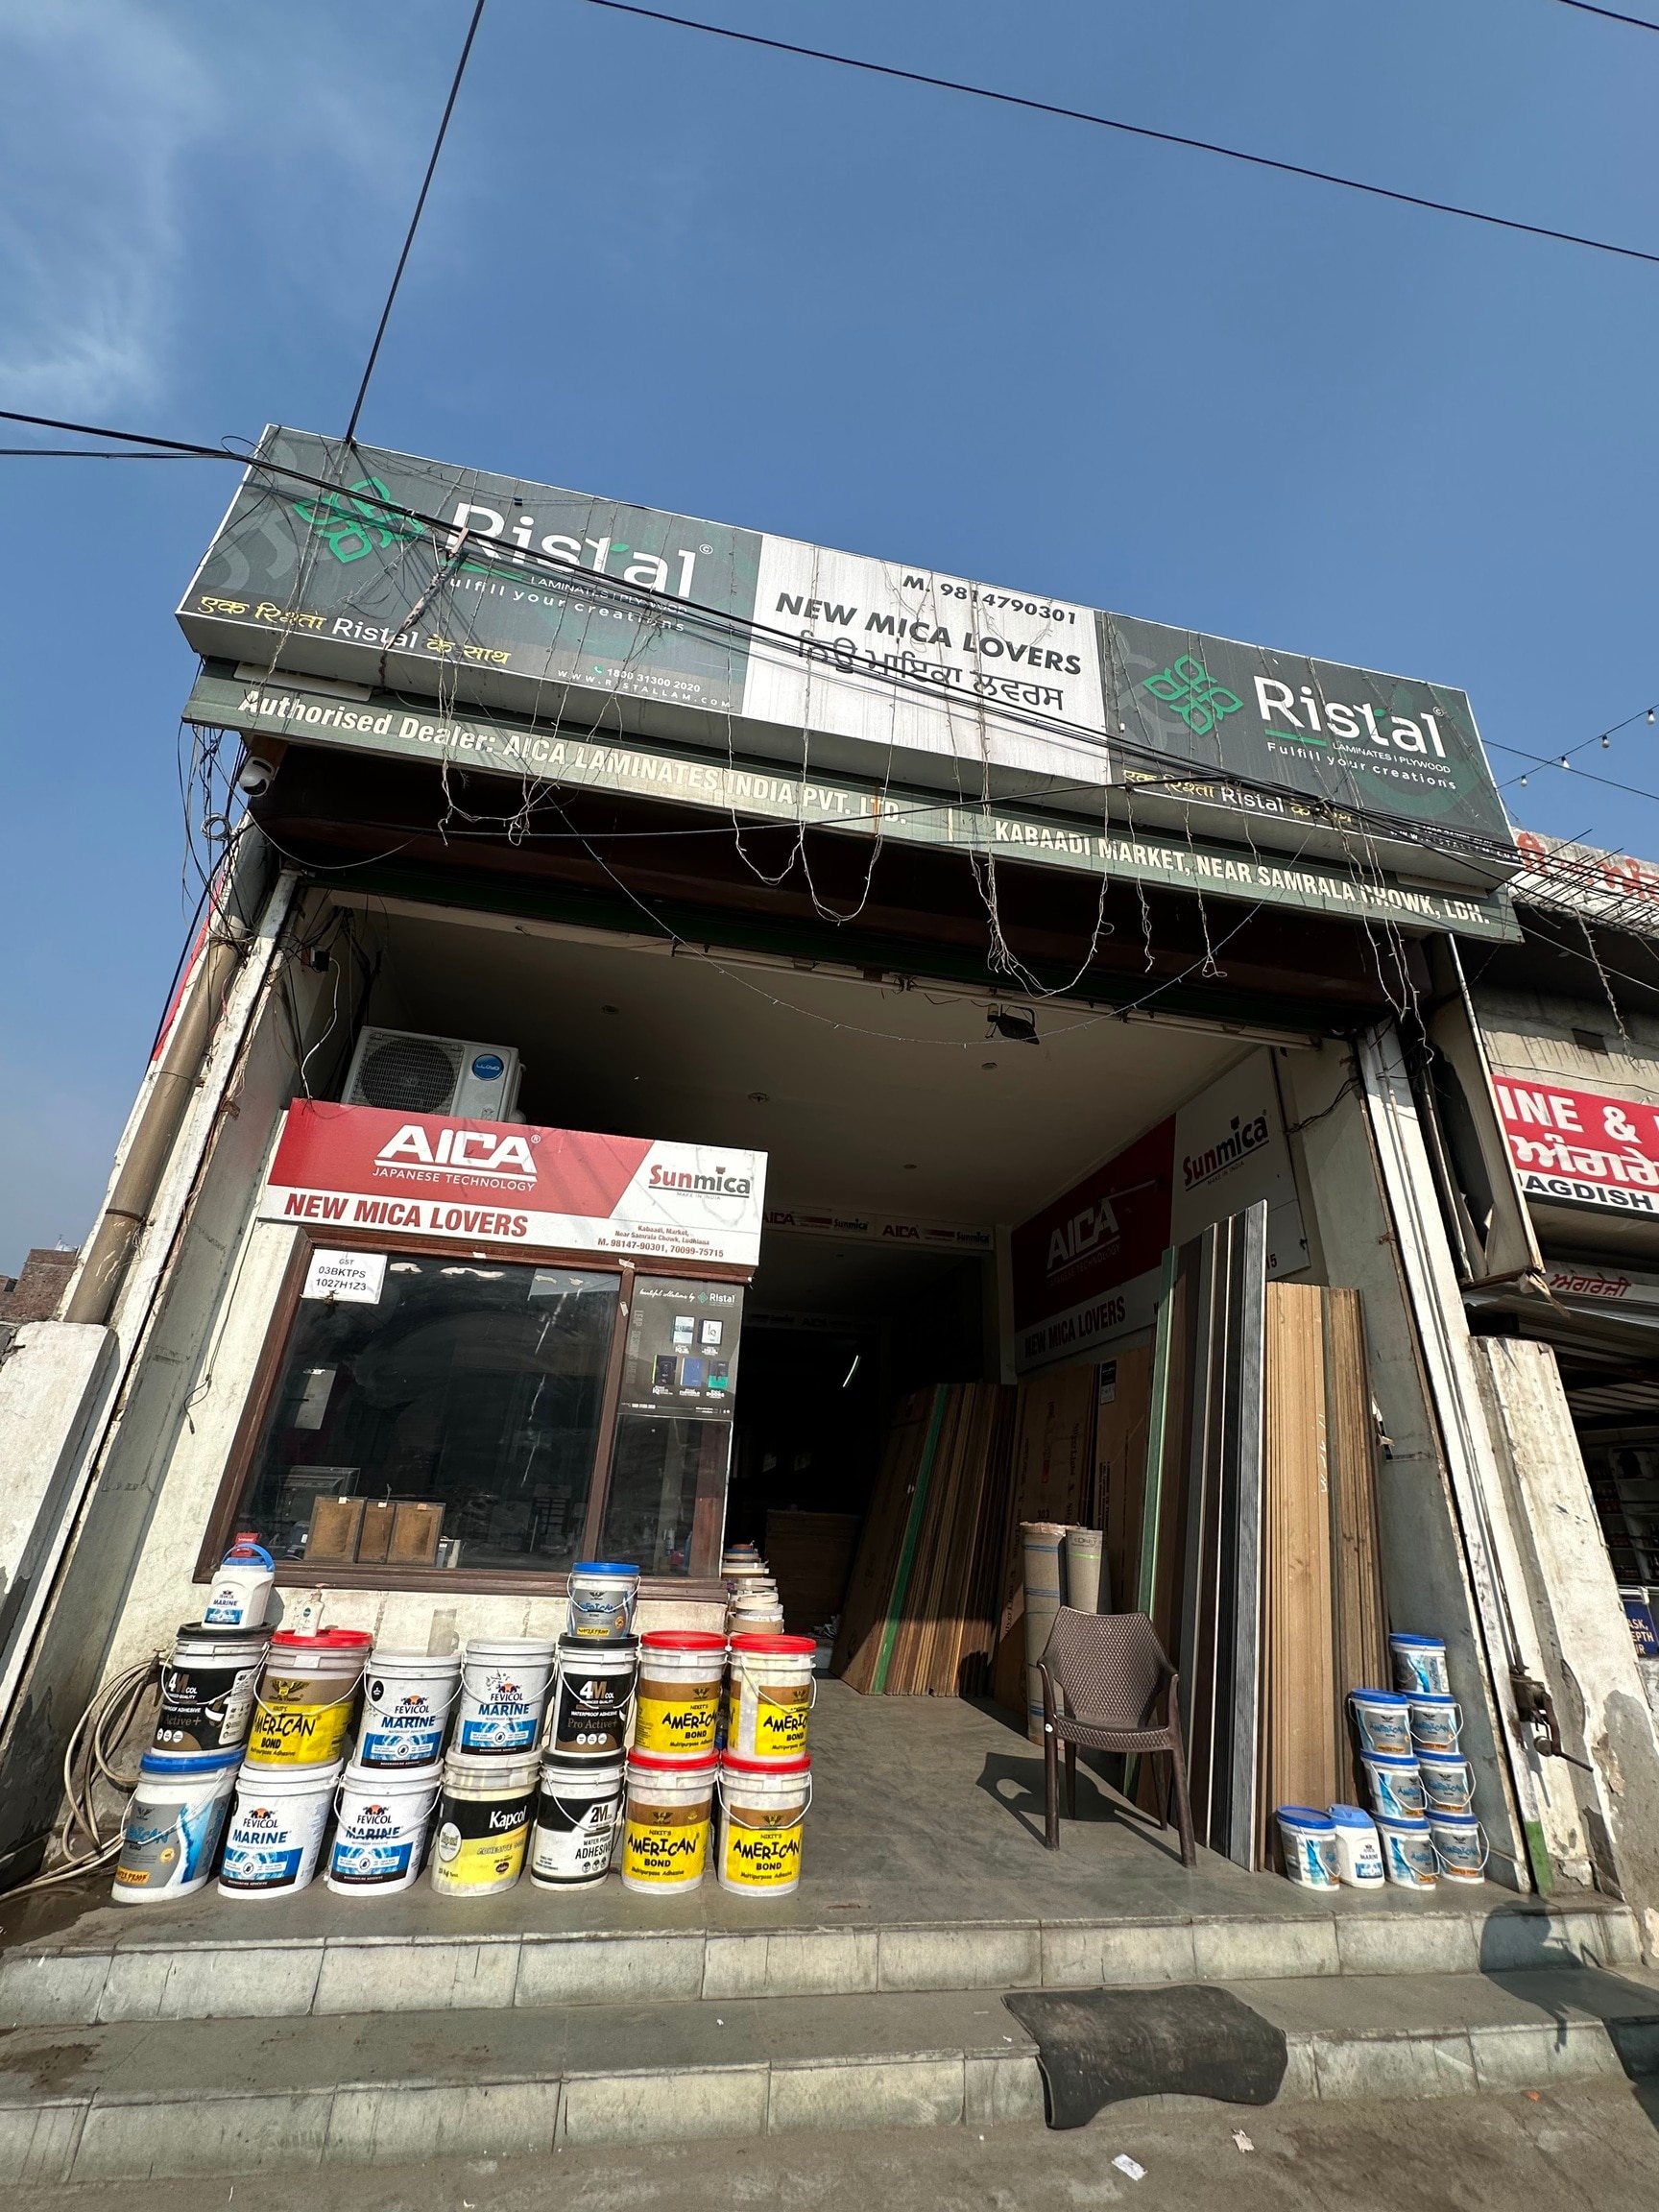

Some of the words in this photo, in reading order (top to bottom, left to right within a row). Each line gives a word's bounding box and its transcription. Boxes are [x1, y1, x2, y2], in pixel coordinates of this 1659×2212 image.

[446, 502, 696, 599] Ristal
[437, 572, 505, 596] ulfill
[514, 589, 565, 608] your
[902, 575, 930, 592] M.
[940, 582, 1076, 625] 9814790301
[198, 595, 250, 614] एक
[332, 617, 419, 648] Ristal
[426, 634, 455, 654] के
[463, 644, 512, 665] साथ
[776, 592, 857, 627] NEW
[865, 612, 951, 648] MICA
[963, 632, 1082, 675] LOVERS
[637, 672, 670, 686] 31300
[673, 679, 701, 693] 2020
[1253, 675, 1447, 758] Ristal
[1267, 741, 1321, 761] Fulfill
[1327, 757, 1366, 772] your
[1372, 764, 1456, 790] creations
[1332, 742, 1392, 761] LAMINATES
[1400, 757, 1451, 774] PLYWOOD
[238, 689, 394, 735] Authorised
[398, 716, 497, 754] Dealer:
[503, 734, 565, 765] AICA
[575, 745, 719, 790] LAMINATES
[727, 774, 795, 805] INDIA
[803, 787, 852, 816] PVT.
[859, 797, 907, 825] LTD.
[995, 820, 1092, 857] KABAADI
[1097, 837, 1191, 877] MARKET,
[1196, 854, 1252, 884] NEAR
[1258, 865, 1356, 902] SAMRALA
[1359, 883, 1441, 919] CHOWK,
[1442, 899, 1490, 925] LDH.
[1221, 785, 1284, 813] Ristal
[1602, 1106, 1643, 1143] &
[377, 1124, 538, 1173] AICA
[1183, 1115, 1268, 1187] Sunmica
[373, 1166, 440, 1183] JAPANESE
[445, 1174, 535, 1191] TECHNOLOGY
[648, 1165, 751, 1194] Sunmica
[1518, 1173, 1653, 1211] AGDISH
[284, 1193, 349, 1219] NEW
[353, 1200, 421, 1227] MICA
[429, 1207, 528, 1238] LOVERS
[882, 1224, 920, 1238] AICA
[956, 1231, 990, 1243] Sunmica
[1046, 1197, 1119, 1270] AICA
[611, 1238, 667, 1253] 98147-90301,
[670, 1244, 724, 1258] 70099-75715
[319, 1266, 366, 1278] 03BKTPS
[316, 1278, 367, 1291] 1027H1Z3
[1024, 1329, 1046, 1358] NEW
[1048, 1316, 1076, 1349] MICA
[1078, 1296, 1125, 1335] LOVERS
[491, 1693, 523, 1701] FEVICOL
[395, 1705, 429, 1714] FEVICOL
[478, 1704, 530, 1716] MARINE
[254, 1710, 316, 1737] AMERICAN
[381, 1716, 436, 1728] MARINE
[567, 1718, 583, 1728] Pro
[261, 1737, 281, 1748] BOND
[685, 1730, 707, 1739] BOND
[786, 1733, 804, 1742] BOND
[243, 1818, 278, 1828] FEVICOL
[357, 1815, 392, 1824] FEVICOL
[489, 1805, 527, 1829] Kapcol
[232, 1829, 288, 1844] MARINE
[346, 1826, 400, 1839] MARINE
[583, 1838, 599, 1846] WATER
[575, 1840, 612, 1860] ADHESIVE
[628, 1833, 696, 1856] AMERICAN
[733, 1838, 801, 1860] AMERICAN
[644, 1859, 671, 1867] BOND
